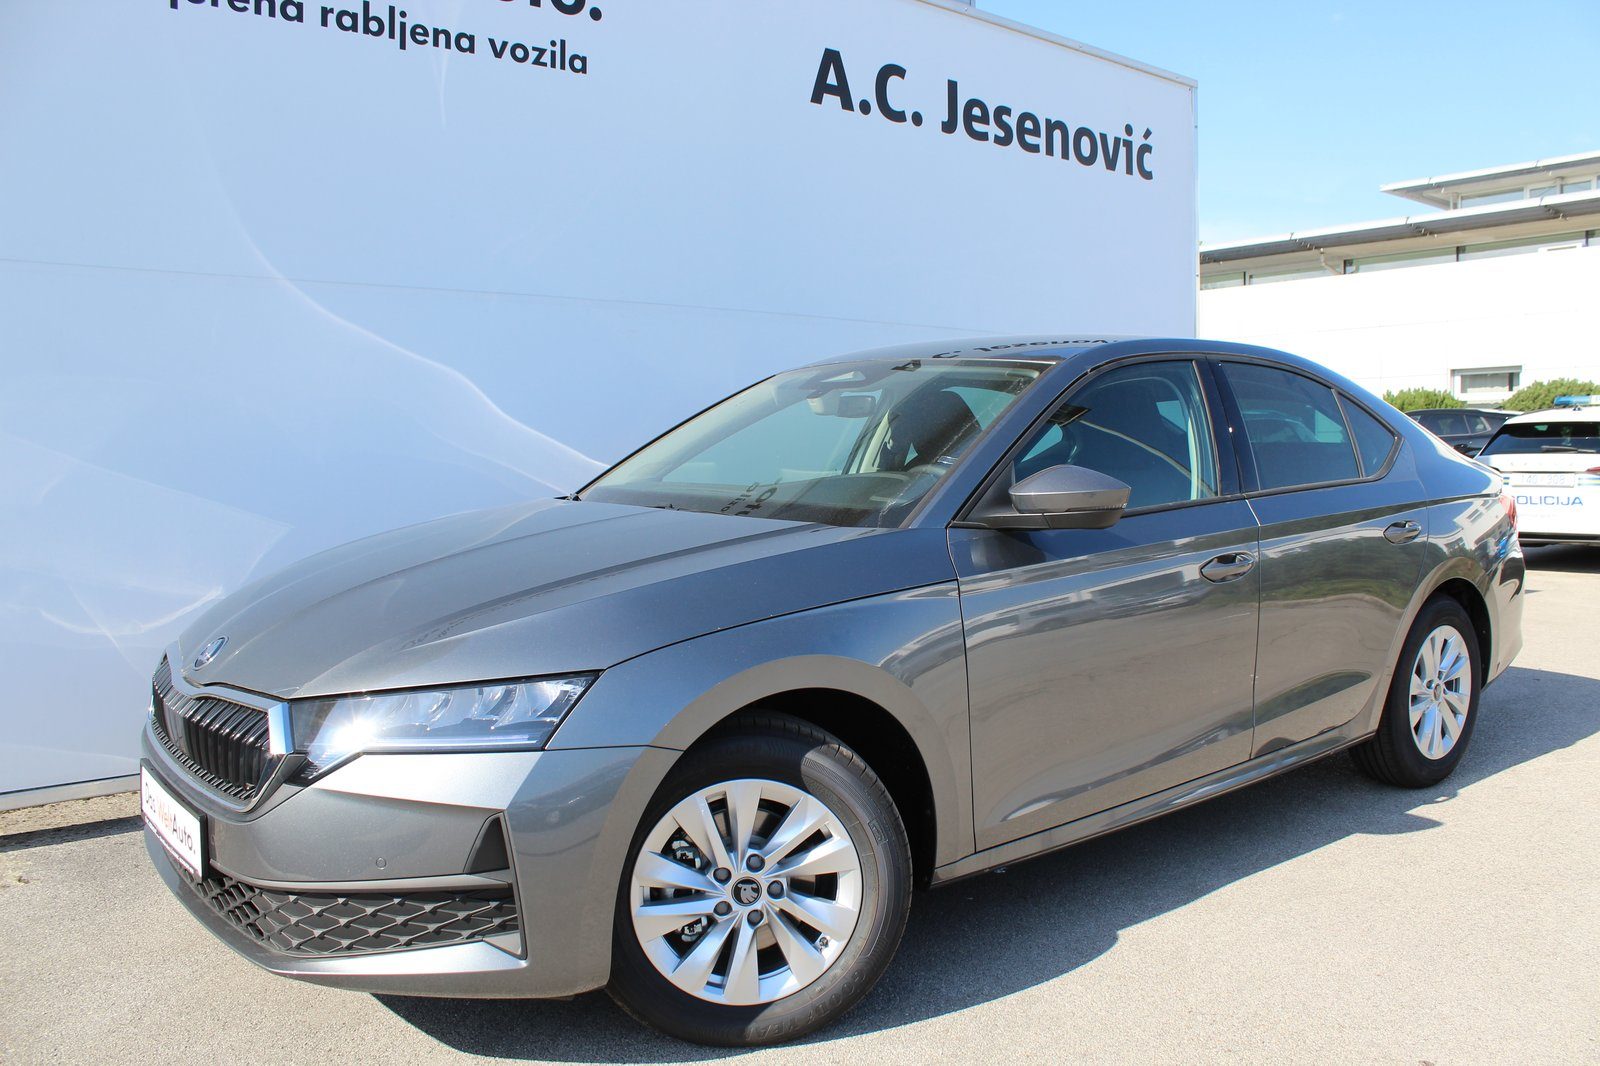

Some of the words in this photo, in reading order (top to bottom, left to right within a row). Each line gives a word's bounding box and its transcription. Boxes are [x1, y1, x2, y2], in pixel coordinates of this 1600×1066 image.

[320, 0, 476, 54] rabljena
[488, 37, 588, 74] vozila
[810, 48, 923, 127] A.C.
[941, 79, 1154, 181] Jesenović
